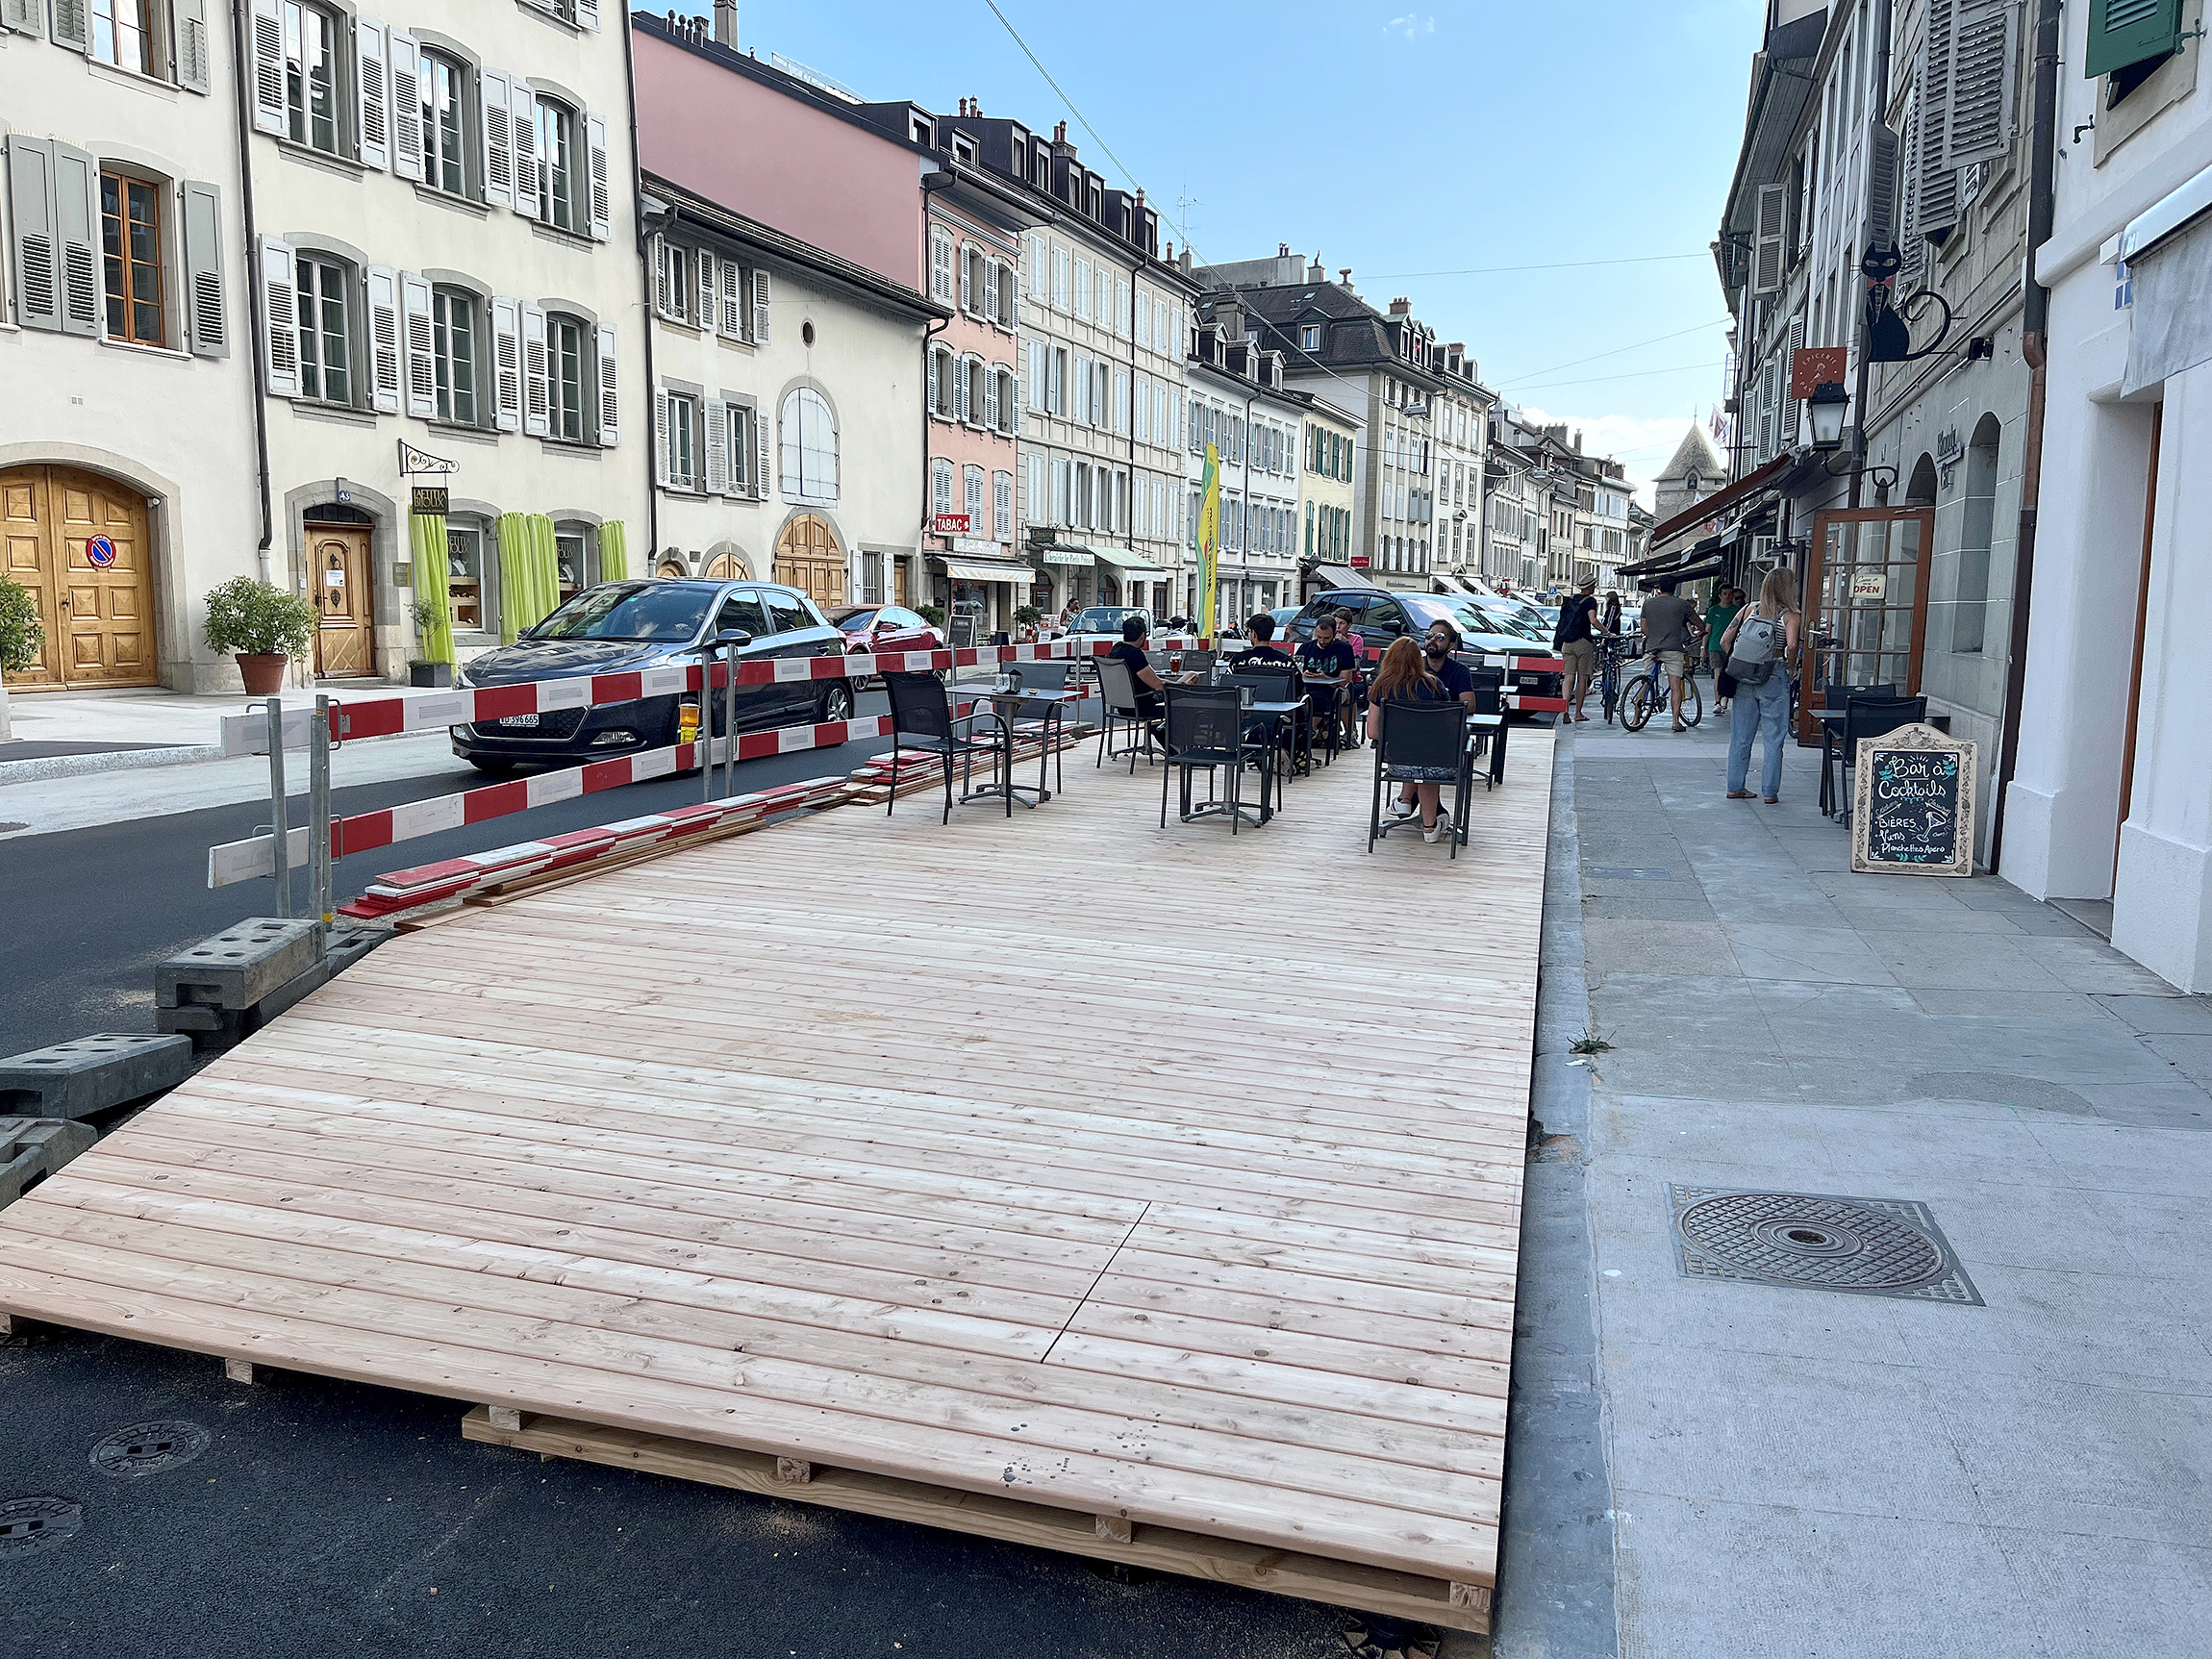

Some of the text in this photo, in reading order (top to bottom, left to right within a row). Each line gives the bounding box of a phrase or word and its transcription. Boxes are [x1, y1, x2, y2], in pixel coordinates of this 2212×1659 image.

[414, 496, 444, 508] BIJOUX
[937, 518, 963, 531] TABAC
[1889, 755, 1929, 778] Bar
[1878, 780, 1947, 799] Cocktails
[1879, 816, 1917, 828] BIÈRES
